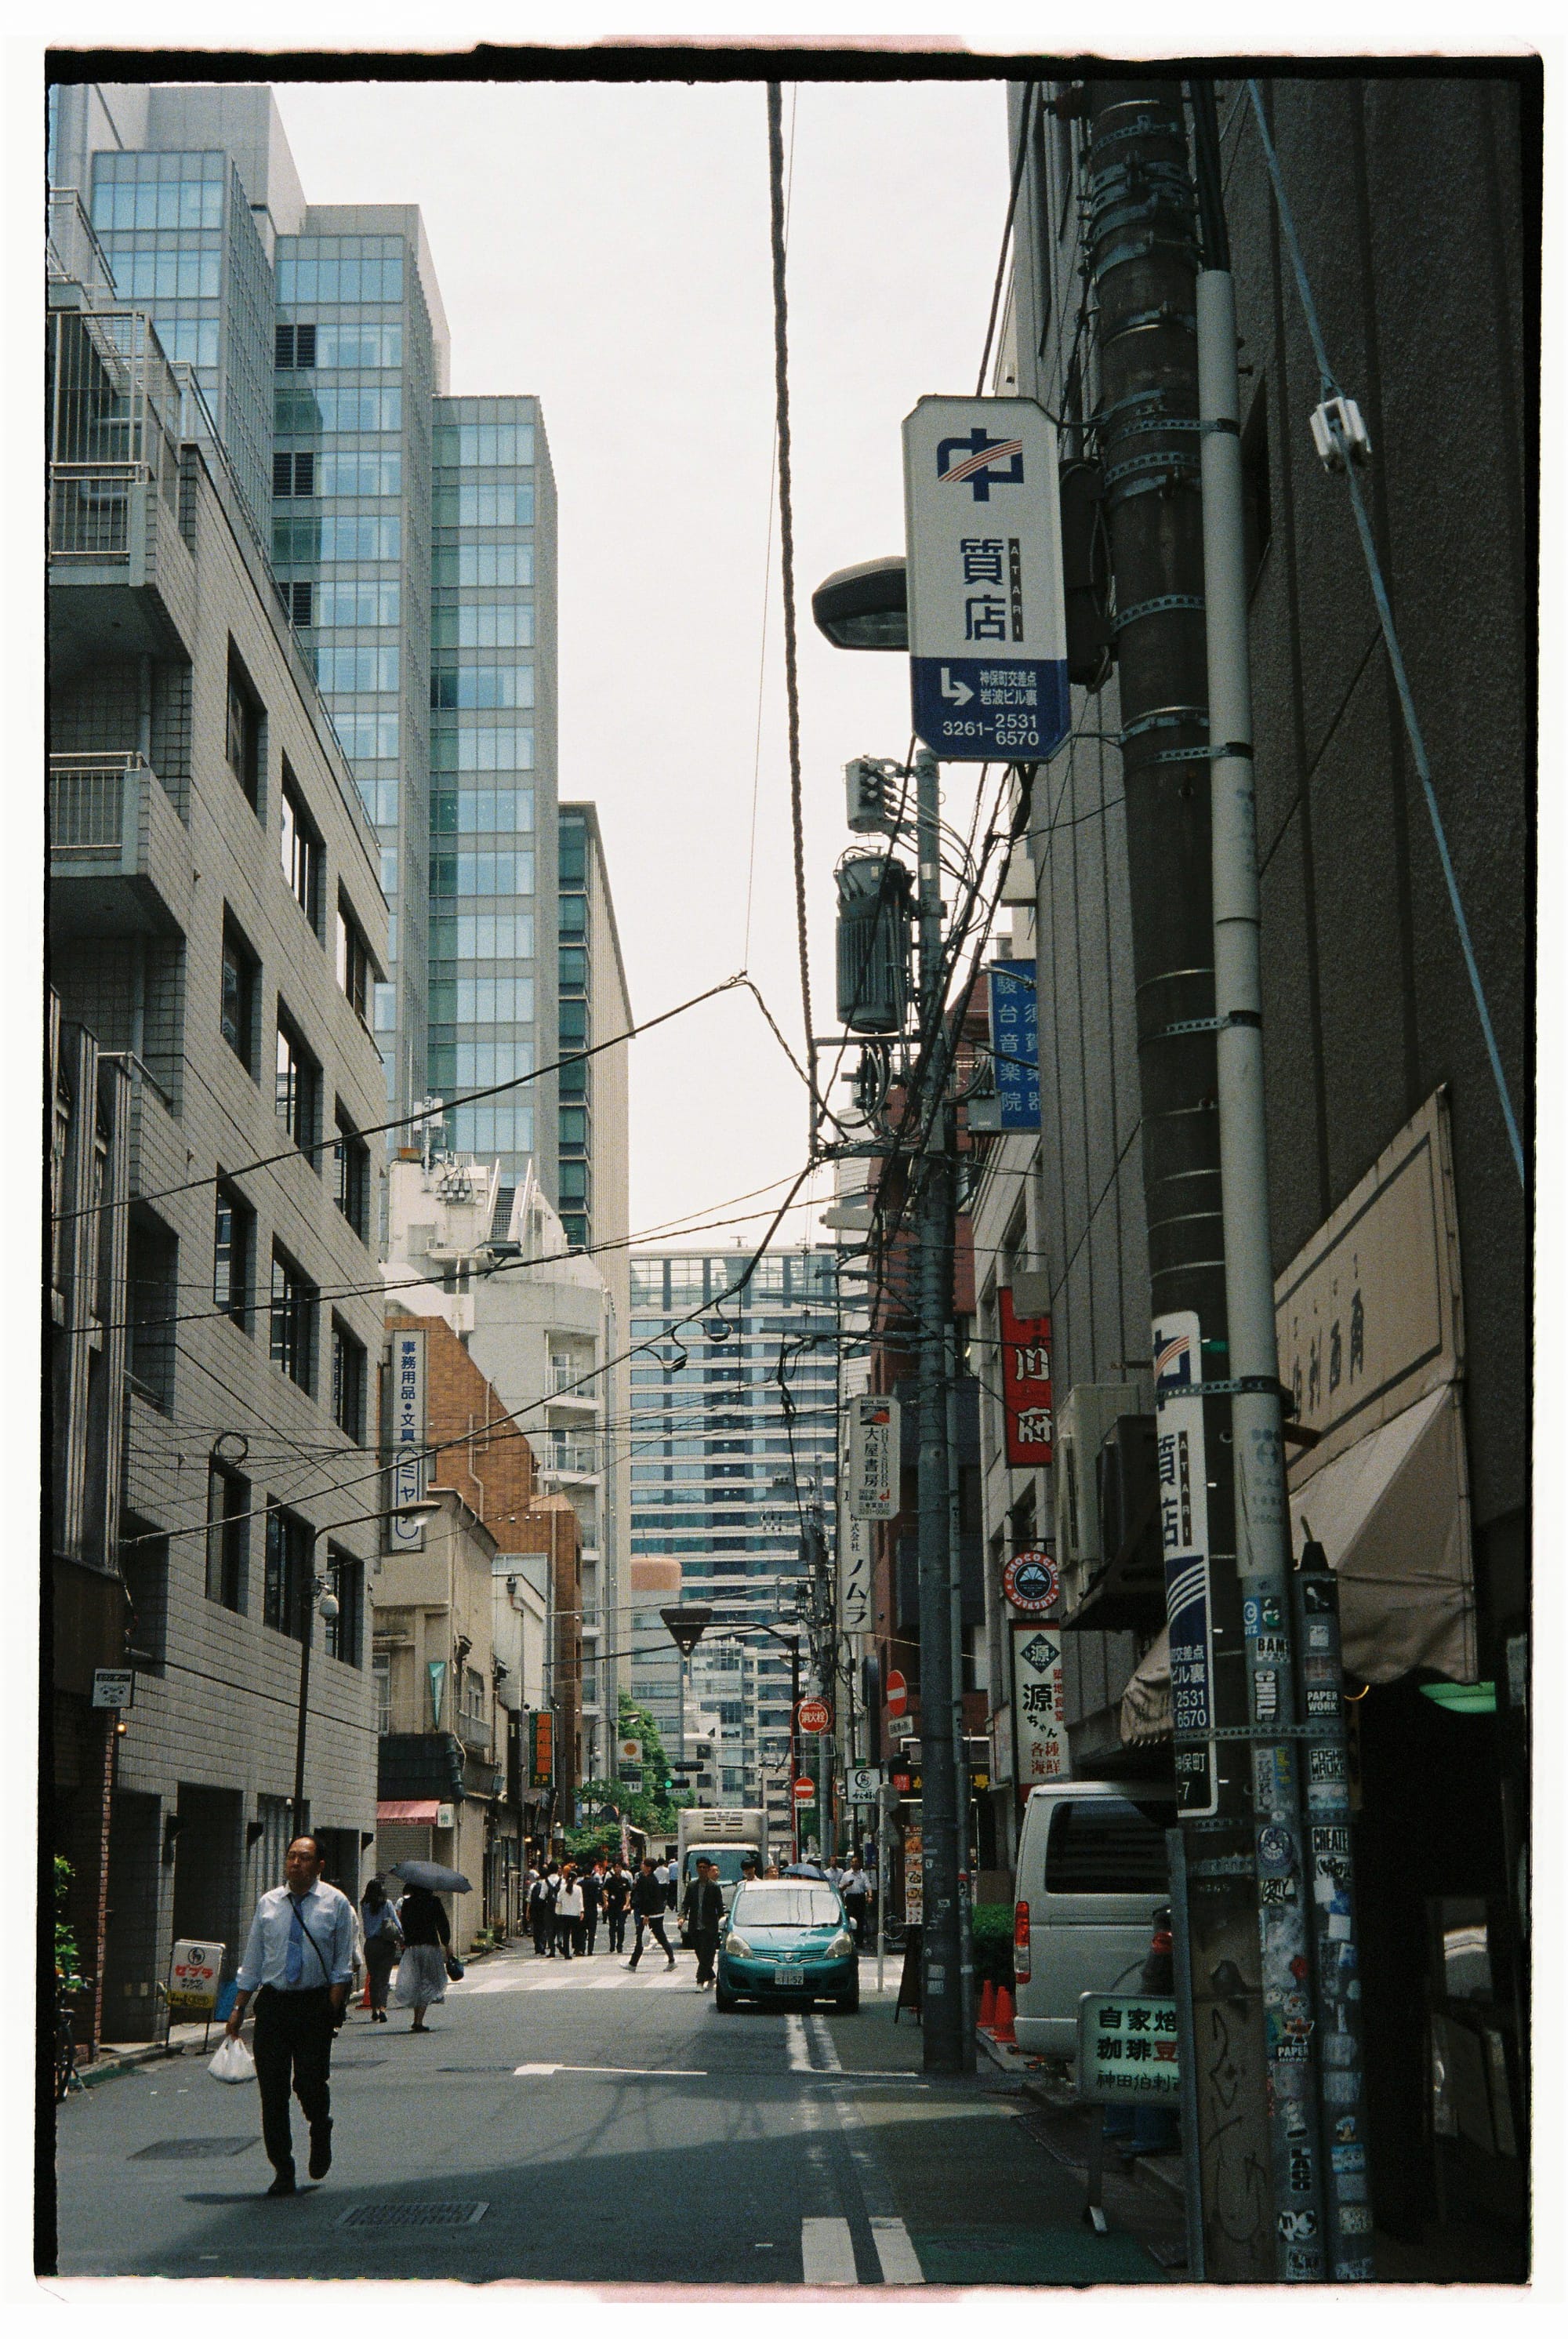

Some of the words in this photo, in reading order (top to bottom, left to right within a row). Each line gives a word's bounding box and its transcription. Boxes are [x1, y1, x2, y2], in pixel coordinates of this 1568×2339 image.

[960, 538, 1006, 641] 質店
[1010, 543, 1022, 636] ATARI
[979, 670, 1037, 688] 神保町交差点
[979, 688, 1038, 706] 岩波ビル裏
[942, 719, 994, 737] 3261-
[995, 713, 1037, 728] 2531
[995, 731, 1040, 746] 6570
[996, 975, 1022, 1112] 駿台音楽院
[401, 1341, 416, 1443] 事務用品・文具
[864, 1427, 879, 1487] 大屋書房
[846, 1559, 868, 1625] ノムラ
[1176, 1689, 1204, 1708] 2531
[1306, 1691, 1338, 1701] PAPER
[1307, 1701, 1338, 1711] WORK
[800, 1711, 826, 1723] 消火栓
[1177, 1709, 1207, 1728] 6570
[1030, 1741, 1059, 1757] 各種
[1031, 1759, 1061, 1775] 海鮮
[1096, 2037, 1179, 2064] 珈琲豆
